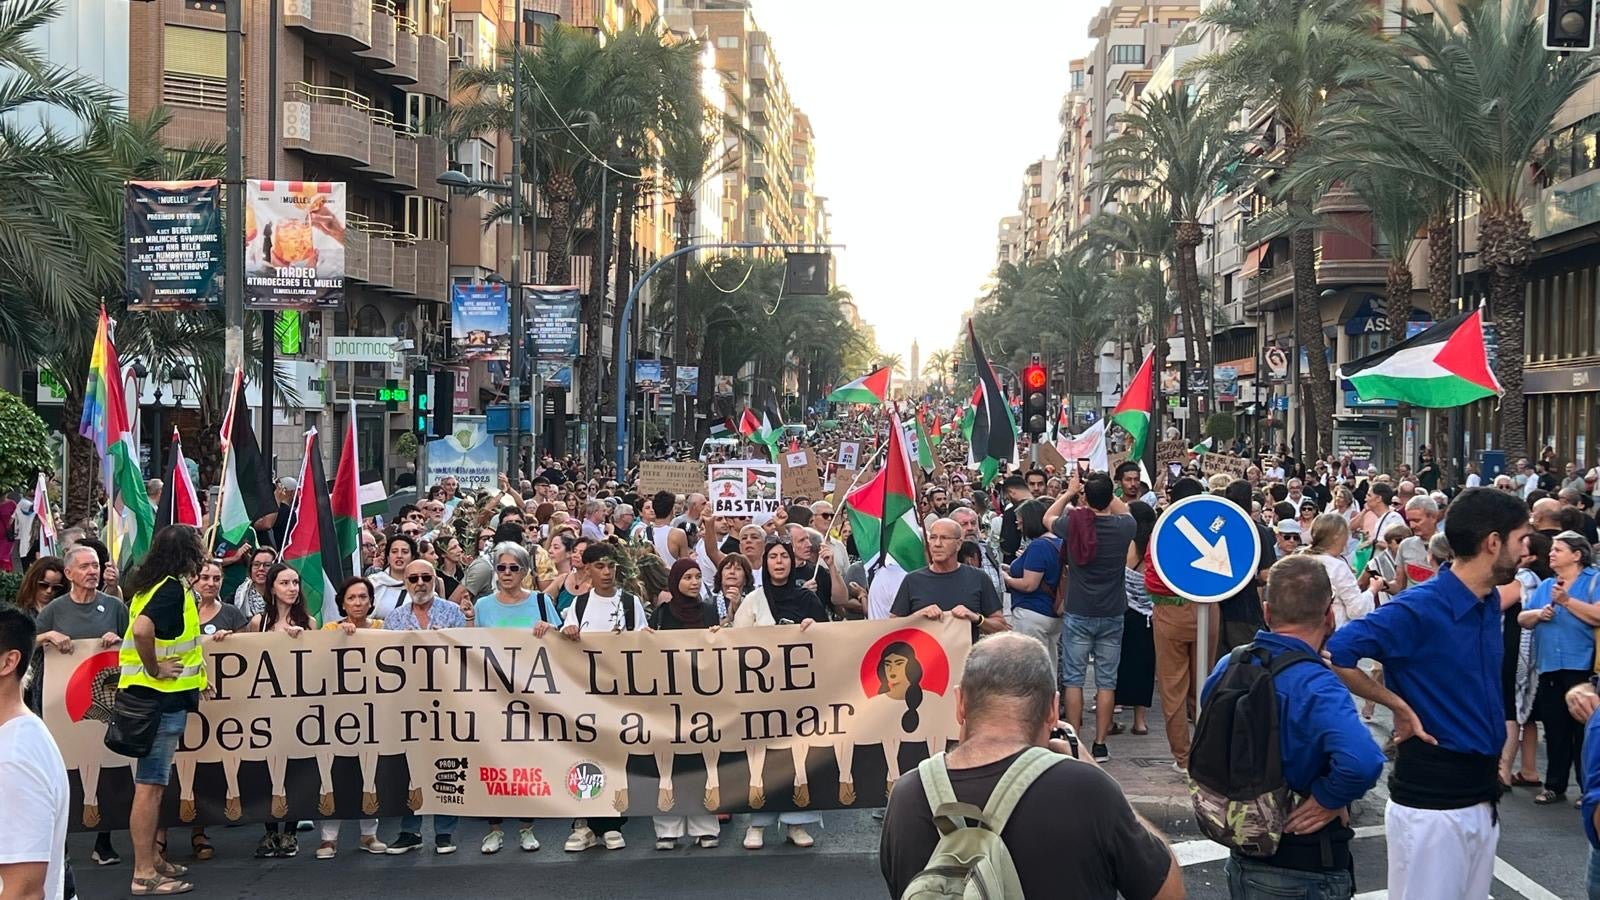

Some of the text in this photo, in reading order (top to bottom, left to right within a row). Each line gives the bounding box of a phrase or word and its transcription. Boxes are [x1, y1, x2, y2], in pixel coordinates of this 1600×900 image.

[171, 227, 192, 235] BERET
[145, 235, 178, 243] MALINCHE
[180, 234, 218, 243] SYMPHONIC
[165, 243, 180, 251] ANA
[195, 251, 211, 259] FEST
[155, 263, 168, 271] THE
[169, 263, 209, 271] WATERBOYS
[275, 266, 316, 279] TARDEO
[246, 277, 343, 288] ATARDECERES EL MUELLE
[716, 499, 780, 513] BASTA YA
[209, 643, 816, 700] PALESTINA LLIURE
[178, 700, 854, 751] Des del riu fins a la mar
[440, 760, 456, 769] PROU
[480, 767, 508, 782] BDS
[440, 795, 465, 804] ISRAEL
